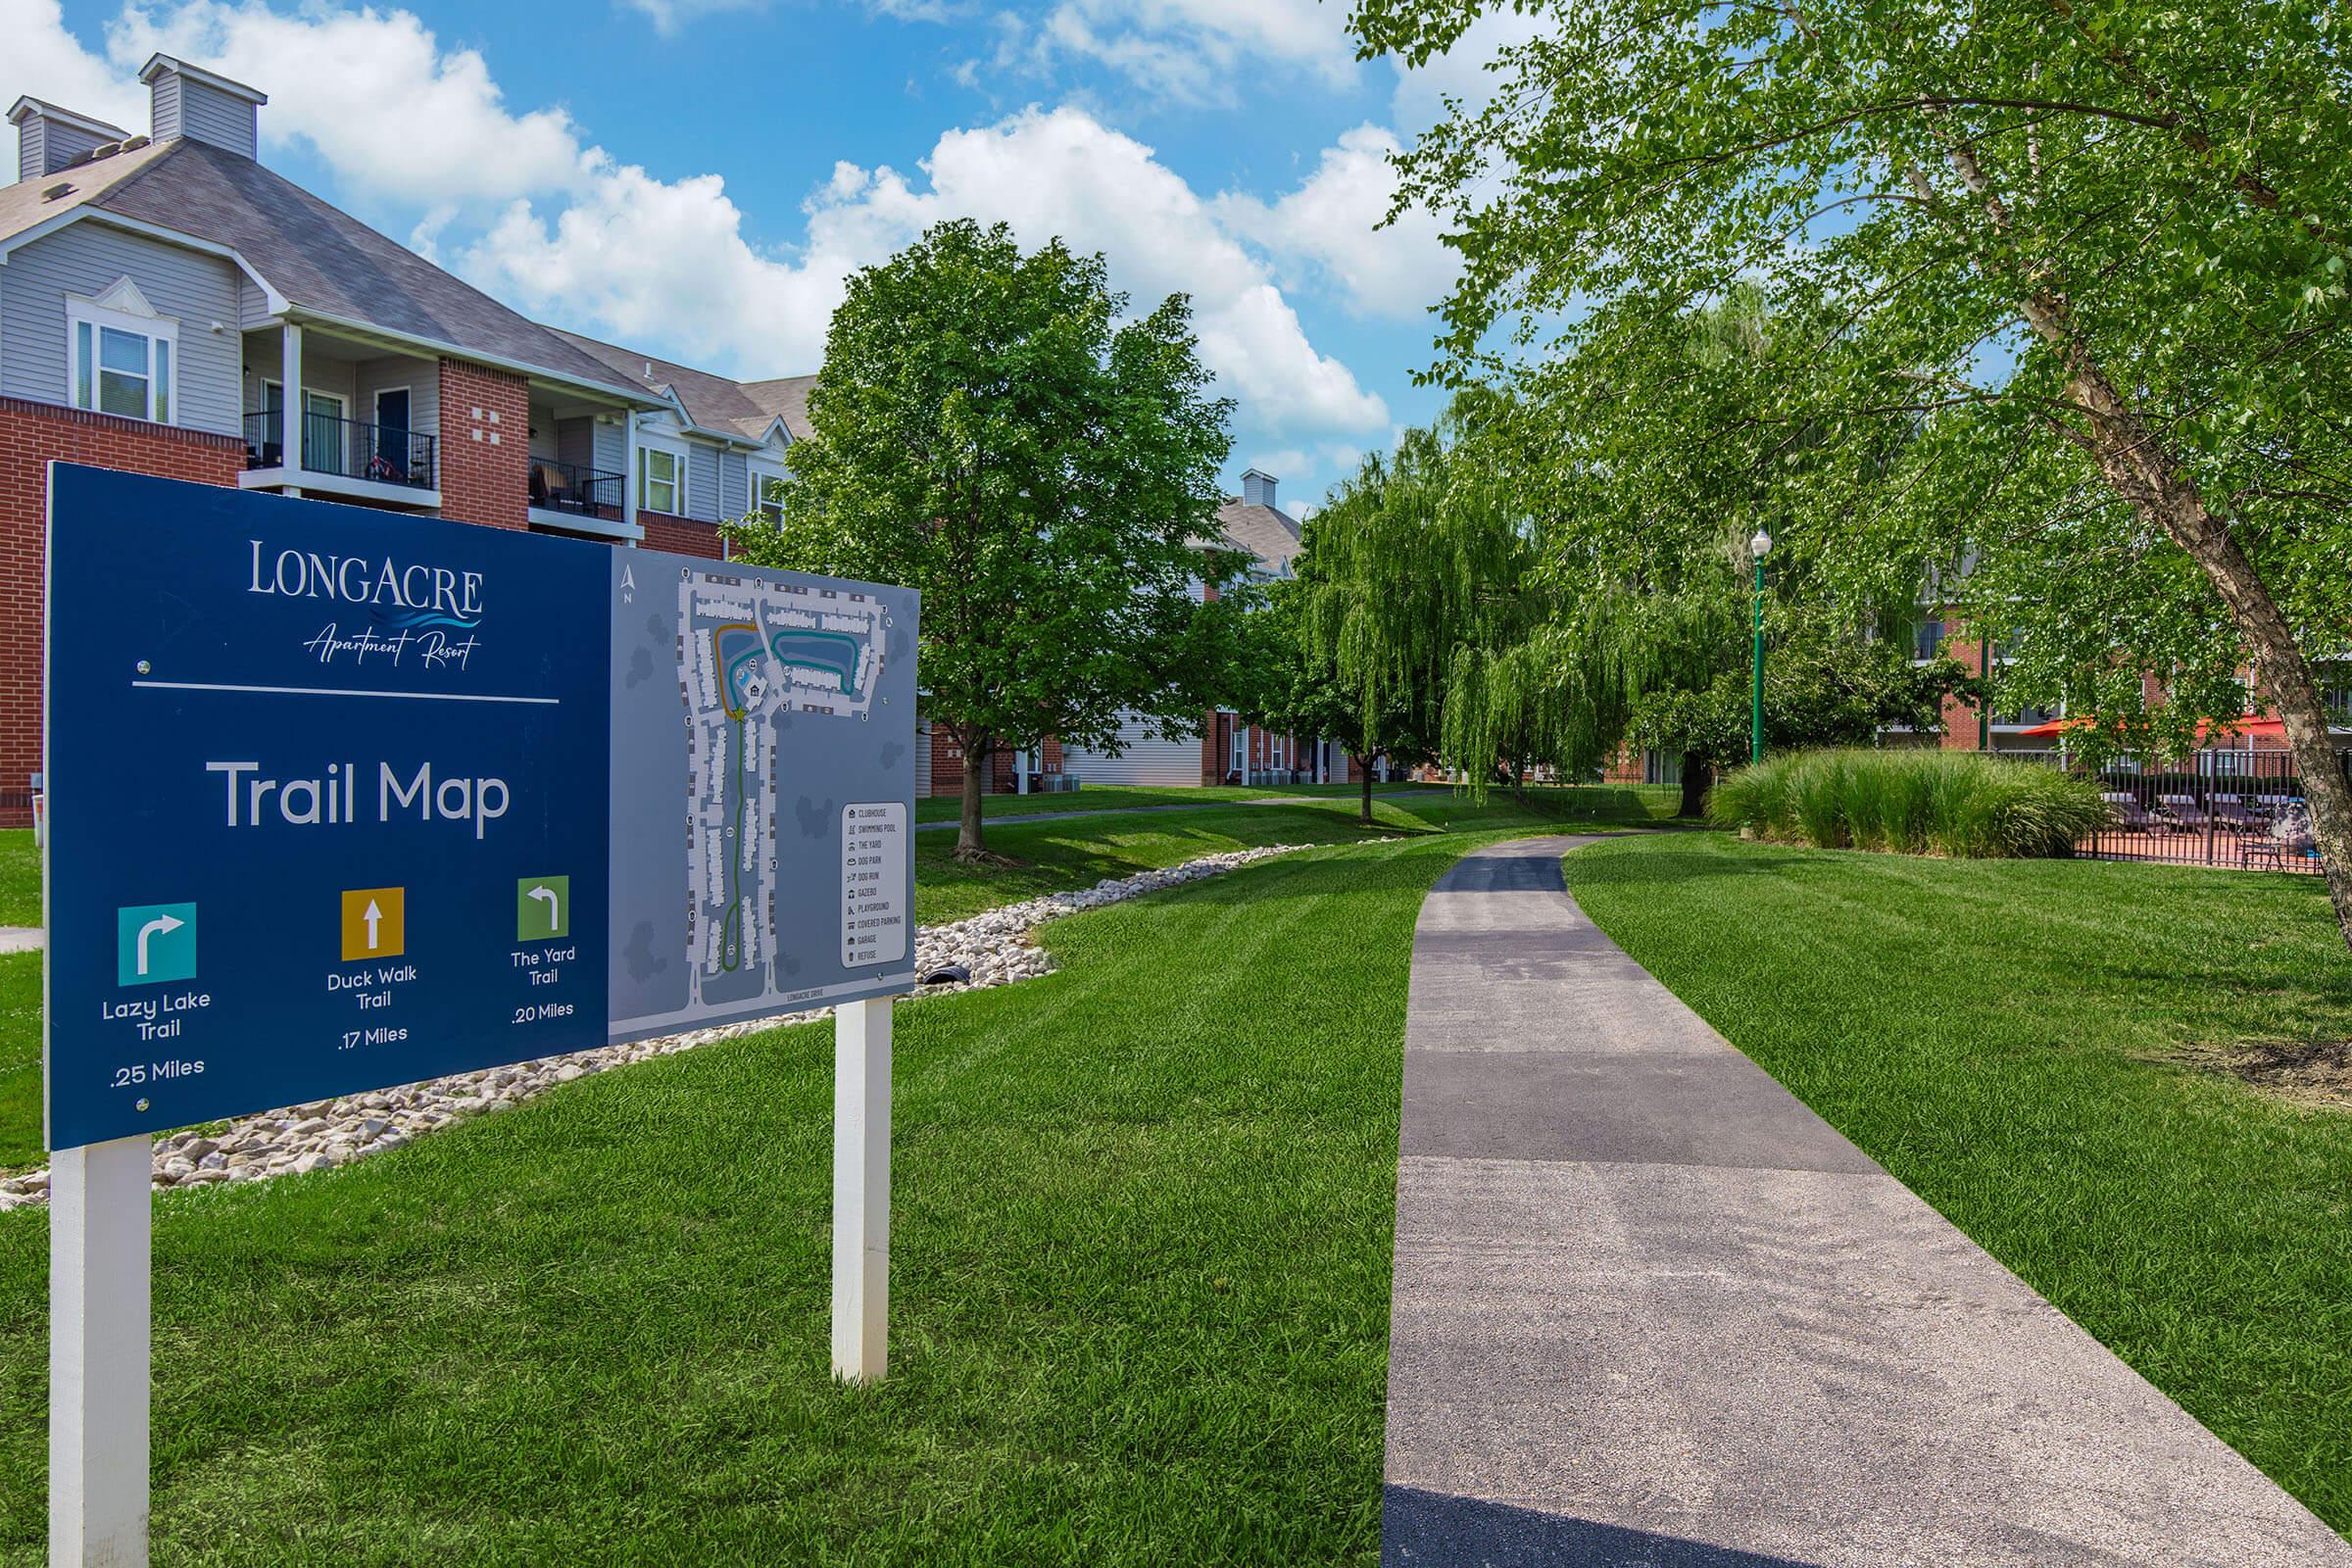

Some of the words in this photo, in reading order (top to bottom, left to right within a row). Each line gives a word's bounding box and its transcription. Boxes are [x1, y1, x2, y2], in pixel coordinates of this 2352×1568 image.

[624, 593, 631, 604] N
[304, 622, 416, 668] Apartment
[416, 629, 482, 671] Resort
[206, 761, 354, 827] Trail
[379, 761, 510, 840] Map
[858, 808, 887, 818] CLUBHOUSE
[858, 824, 883, 834] SWIMMING
[884, 823, 897, 832] POOL
[858, 840, 867, 850] THE
[869, 840, 882, 849] YARD
[858, 857, 868, 865] DOG
[869, 856, 882, 864] PARK
[858, 872, 868, 881] DOG
[869, 871, 879, 880] RUN
[858, 887, 877, 897] GAZEBO
[858, 902, 890, 912] PLAYGROUND
[858, 918, 880, 929] COVERED
[881, 916, 902, 926] PARKING
[858, 934, 877, 945] GARAGE
[511, 952, 541, 967] The
[544, 947, 575, 962] Yard
[858, 950, 877, 960] REFUSE
[327, 969, 372, 992] Duck
[376, 964, 416, 986] Walk
[528, 967, 558, 986] Trail
[102, 998, 158, 1021] Lazy
[163, 991, 212, 1013] Lake
[355, 990, 391, 1010] Trail
[511, 1006, 536, 1025] .20
[538, 1003, 573, 1019] Miles
[136, 1019, 180, 1041] Trail
[337, 1031, 362, 1052] .17
[365, 1025, 408, 1048] Miles
[110, 1065, 147, 1089] .25
[152, 1057, 205, 1082] Miles
